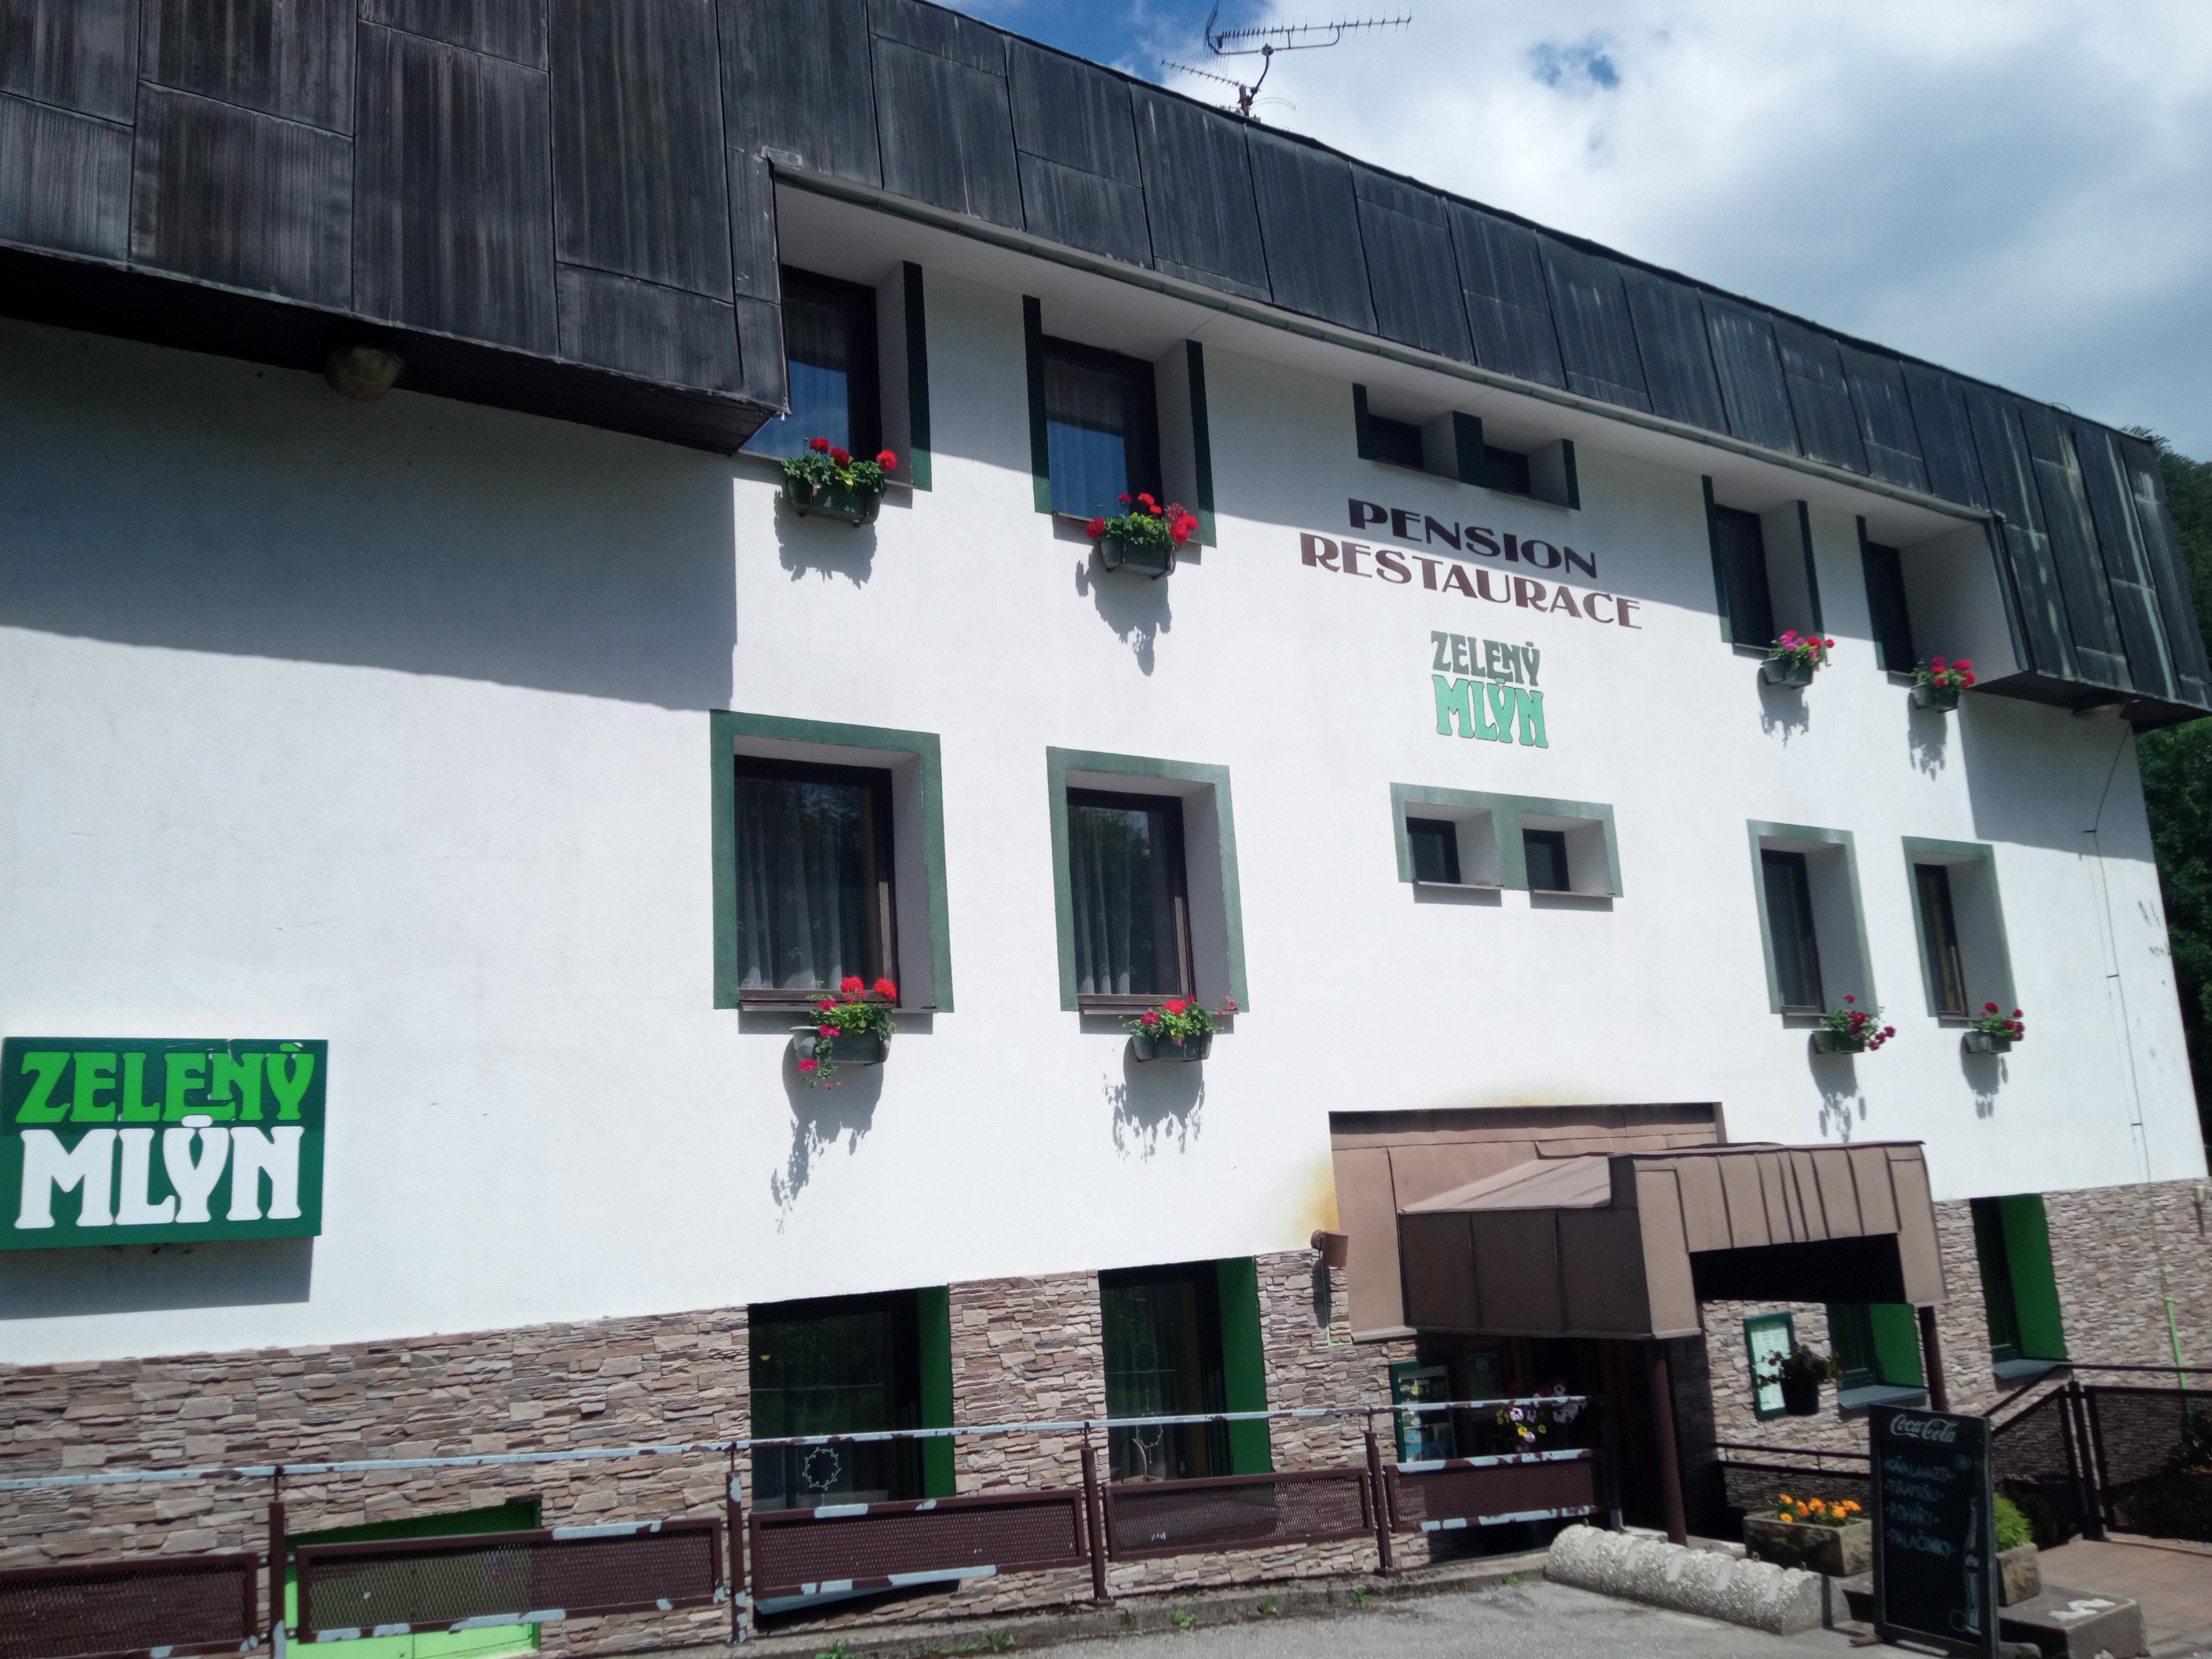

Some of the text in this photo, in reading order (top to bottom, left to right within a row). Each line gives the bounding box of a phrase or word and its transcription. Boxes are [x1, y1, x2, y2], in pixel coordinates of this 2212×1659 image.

[1348, 498, 1598, 579] PENSION
[1300, 532, 1642, 630] RESTAURACE
[1431, 630, 1540, 687] ZELENÝ
[1431, 674, 1548, 748] MLÝN
[15, 1042, 315, 1123] ZELENÝ
[14, 1114, 305, 1229] MLÝN
[1890, 1413, 1959, 1443] Coca-Cola
